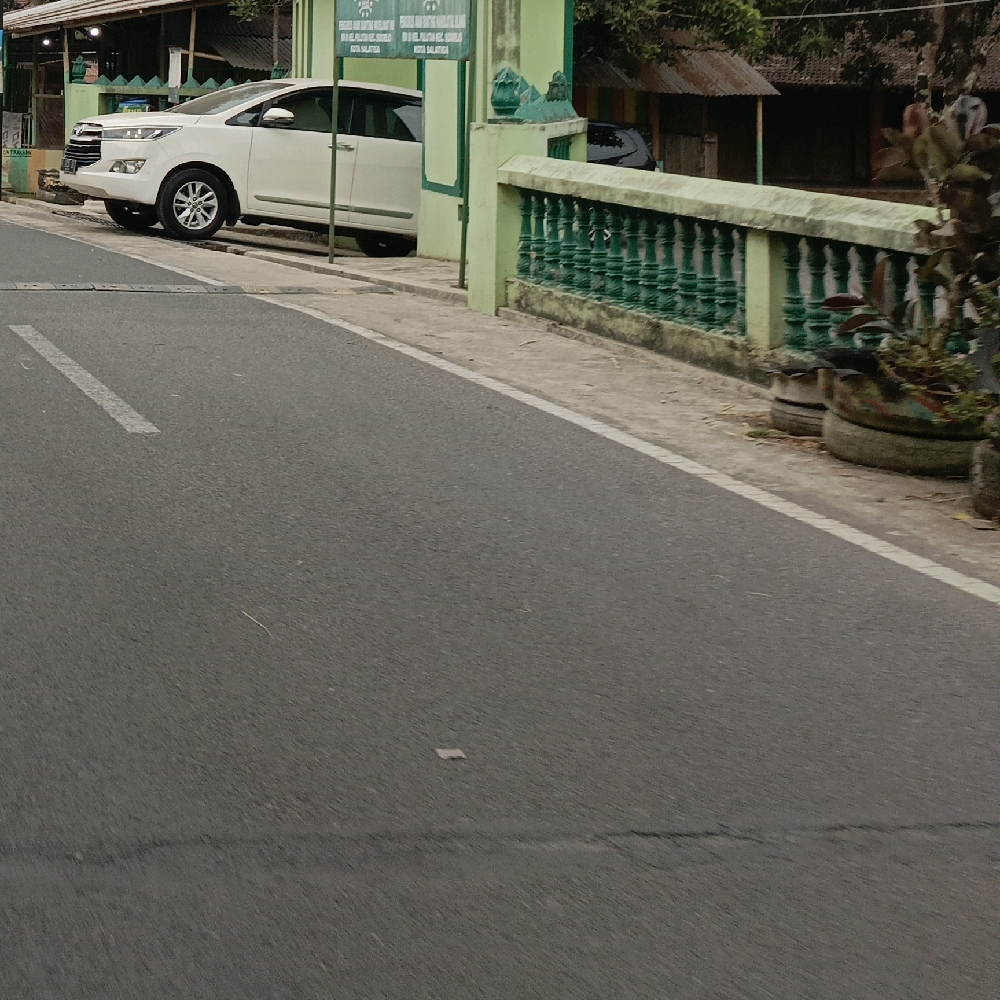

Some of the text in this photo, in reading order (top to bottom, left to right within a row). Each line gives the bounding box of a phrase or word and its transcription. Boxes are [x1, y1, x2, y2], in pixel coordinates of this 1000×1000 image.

[350, 45, 380, 54] KOTA SALATIGA
[414, 45, 449, 54] KOTA SALATIGA
